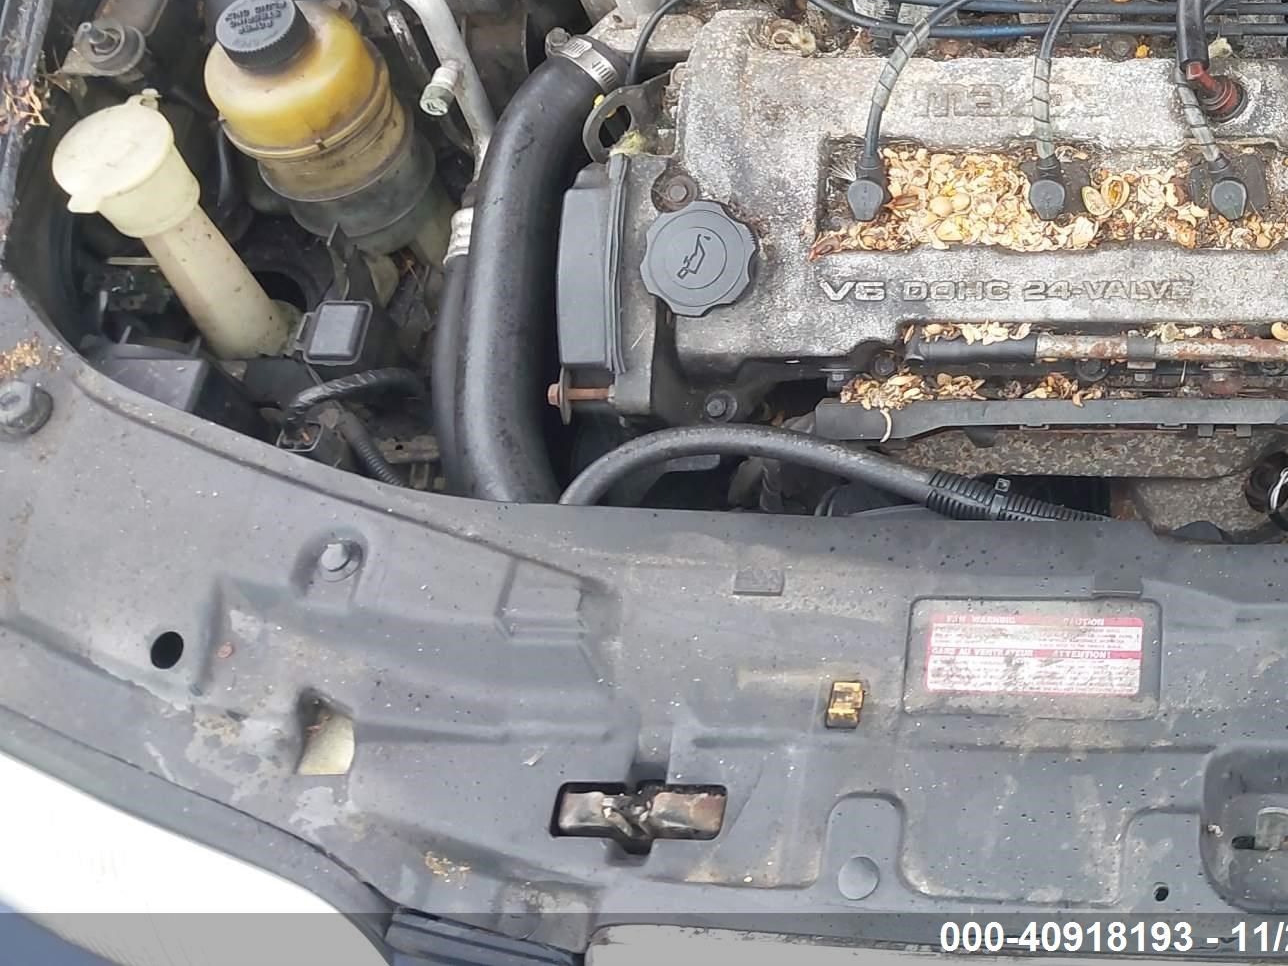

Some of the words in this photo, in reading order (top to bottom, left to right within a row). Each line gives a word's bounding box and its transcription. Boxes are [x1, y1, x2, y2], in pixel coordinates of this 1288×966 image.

[818, 279, 886, 302] V6
[902, 279, 1009, 302] DOHC
[1022, 279, 1193, 302] 24-VALVE
